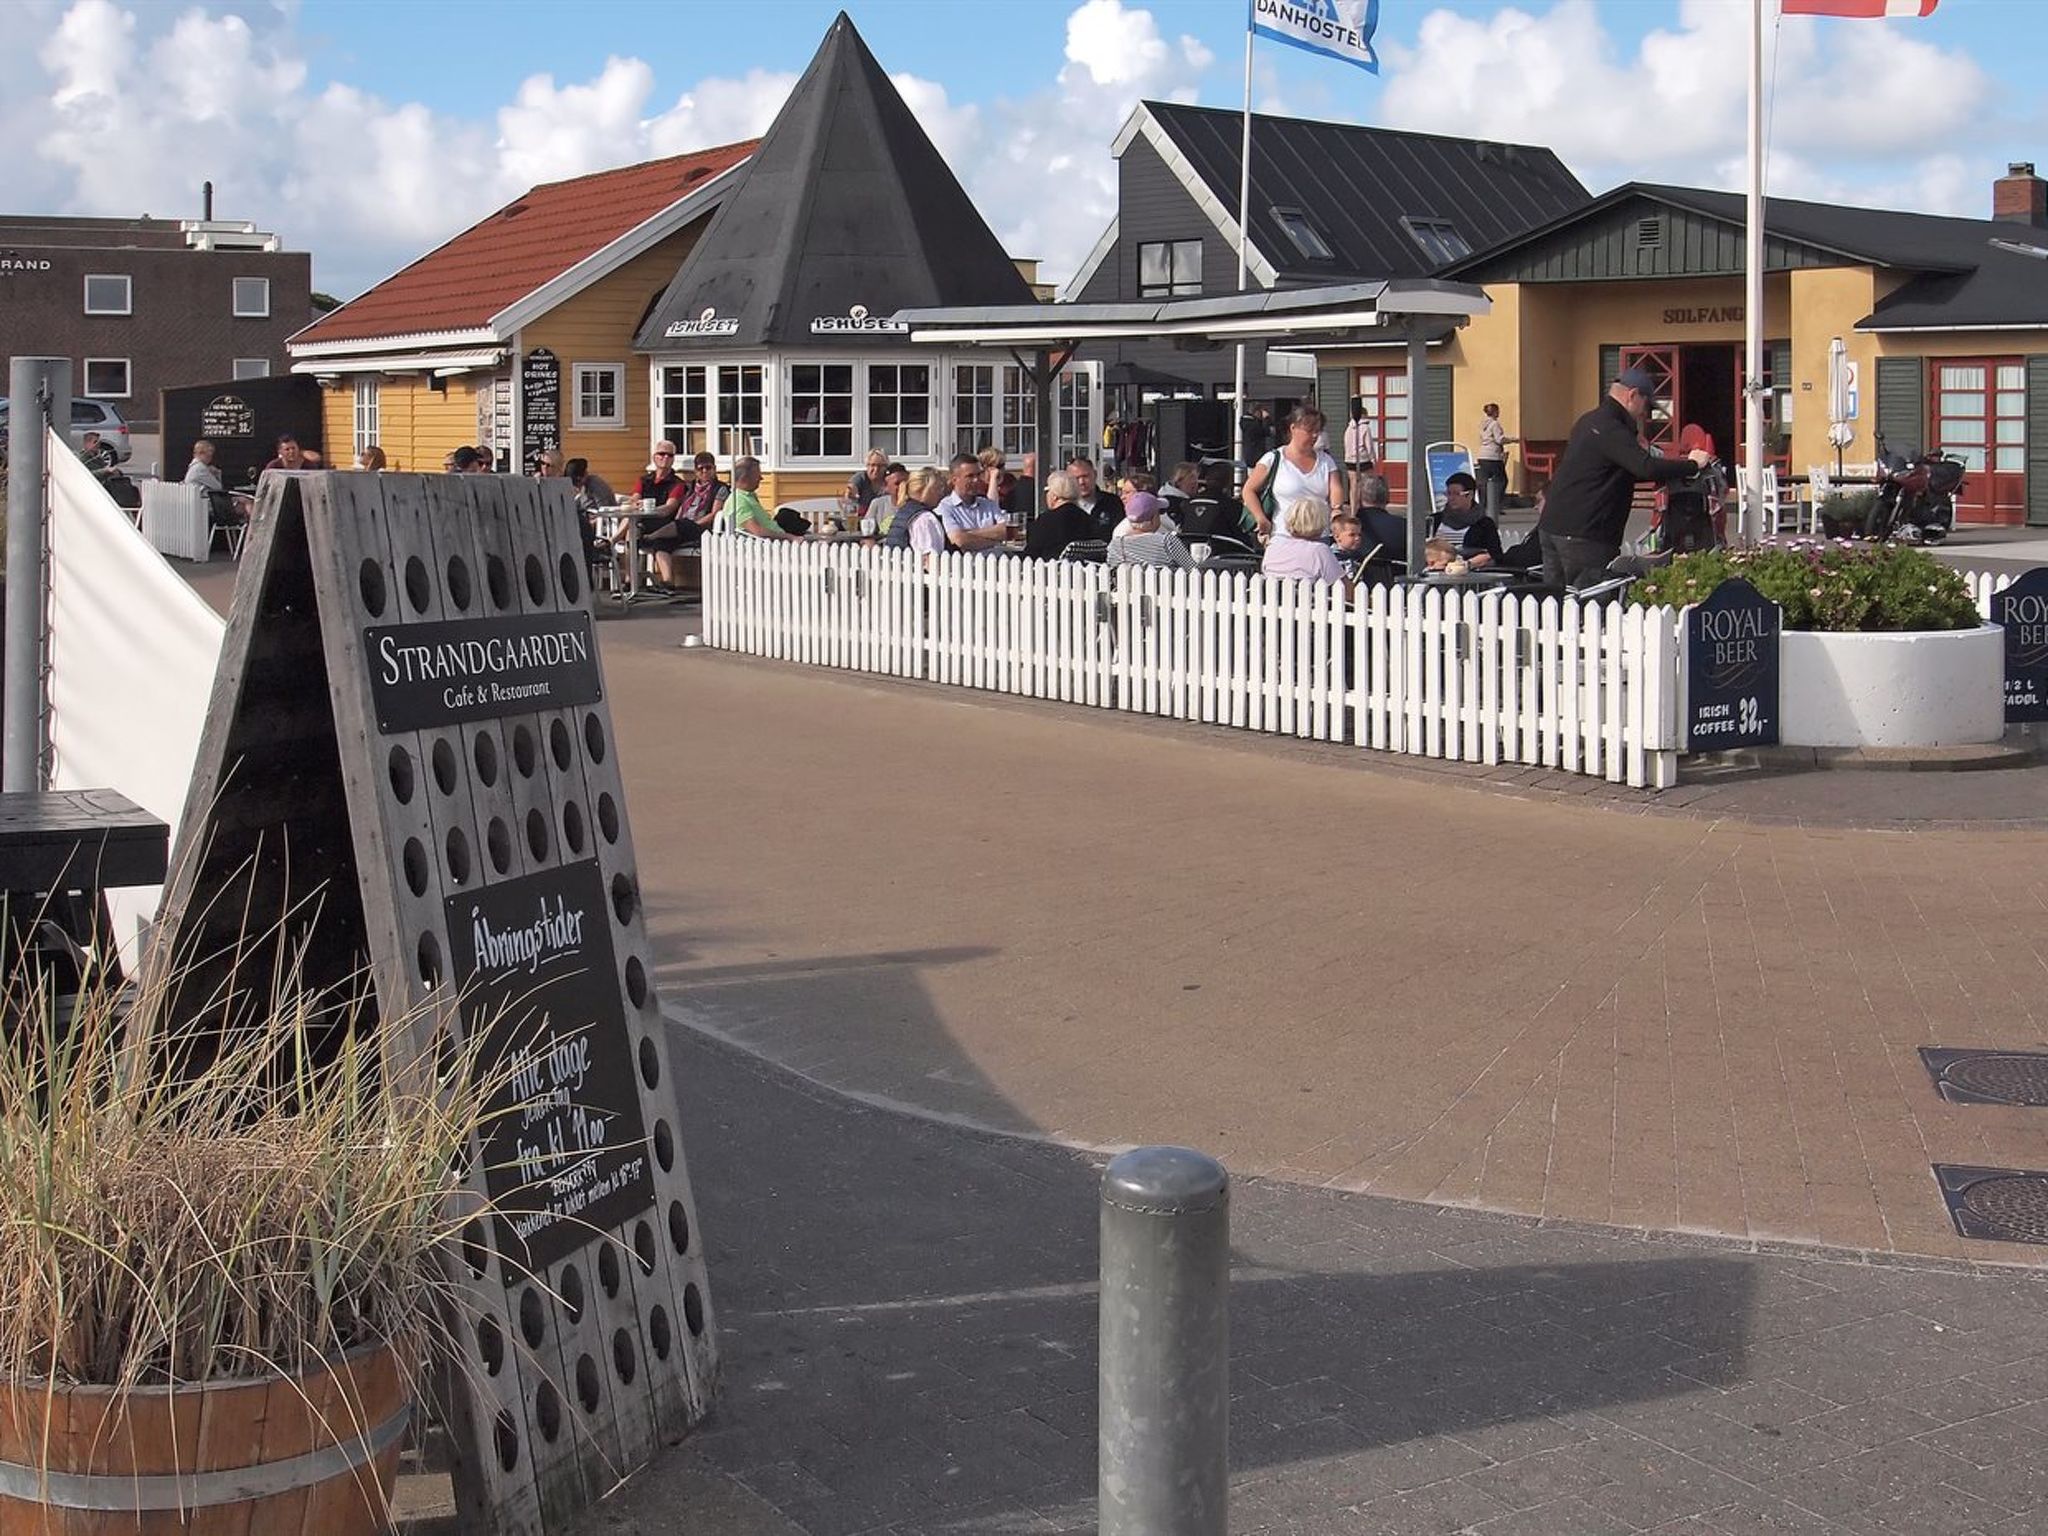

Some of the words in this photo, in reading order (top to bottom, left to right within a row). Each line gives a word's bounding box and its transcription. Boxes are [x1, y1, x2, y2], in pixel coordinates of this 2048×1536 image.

[669, 319, 738, 333] ISHUSET
[1701, 607, 1768, 642] ROYAL
[379, 630, 588, 686] STRANDGAARDEN
[1715, 639, 1758, 665] BEER
[443, 684, 474, 709] Cafe
[478, 685, 488, 703] &
[491, 681, 551, 702] Restaurant
[1699, 704, 1730, 719] IRISH
[1692, 719, 1736, 736] COFFEE
[471, 894, 584, 974] Åbningstider
[549, 1029, 592, 1092] dage
